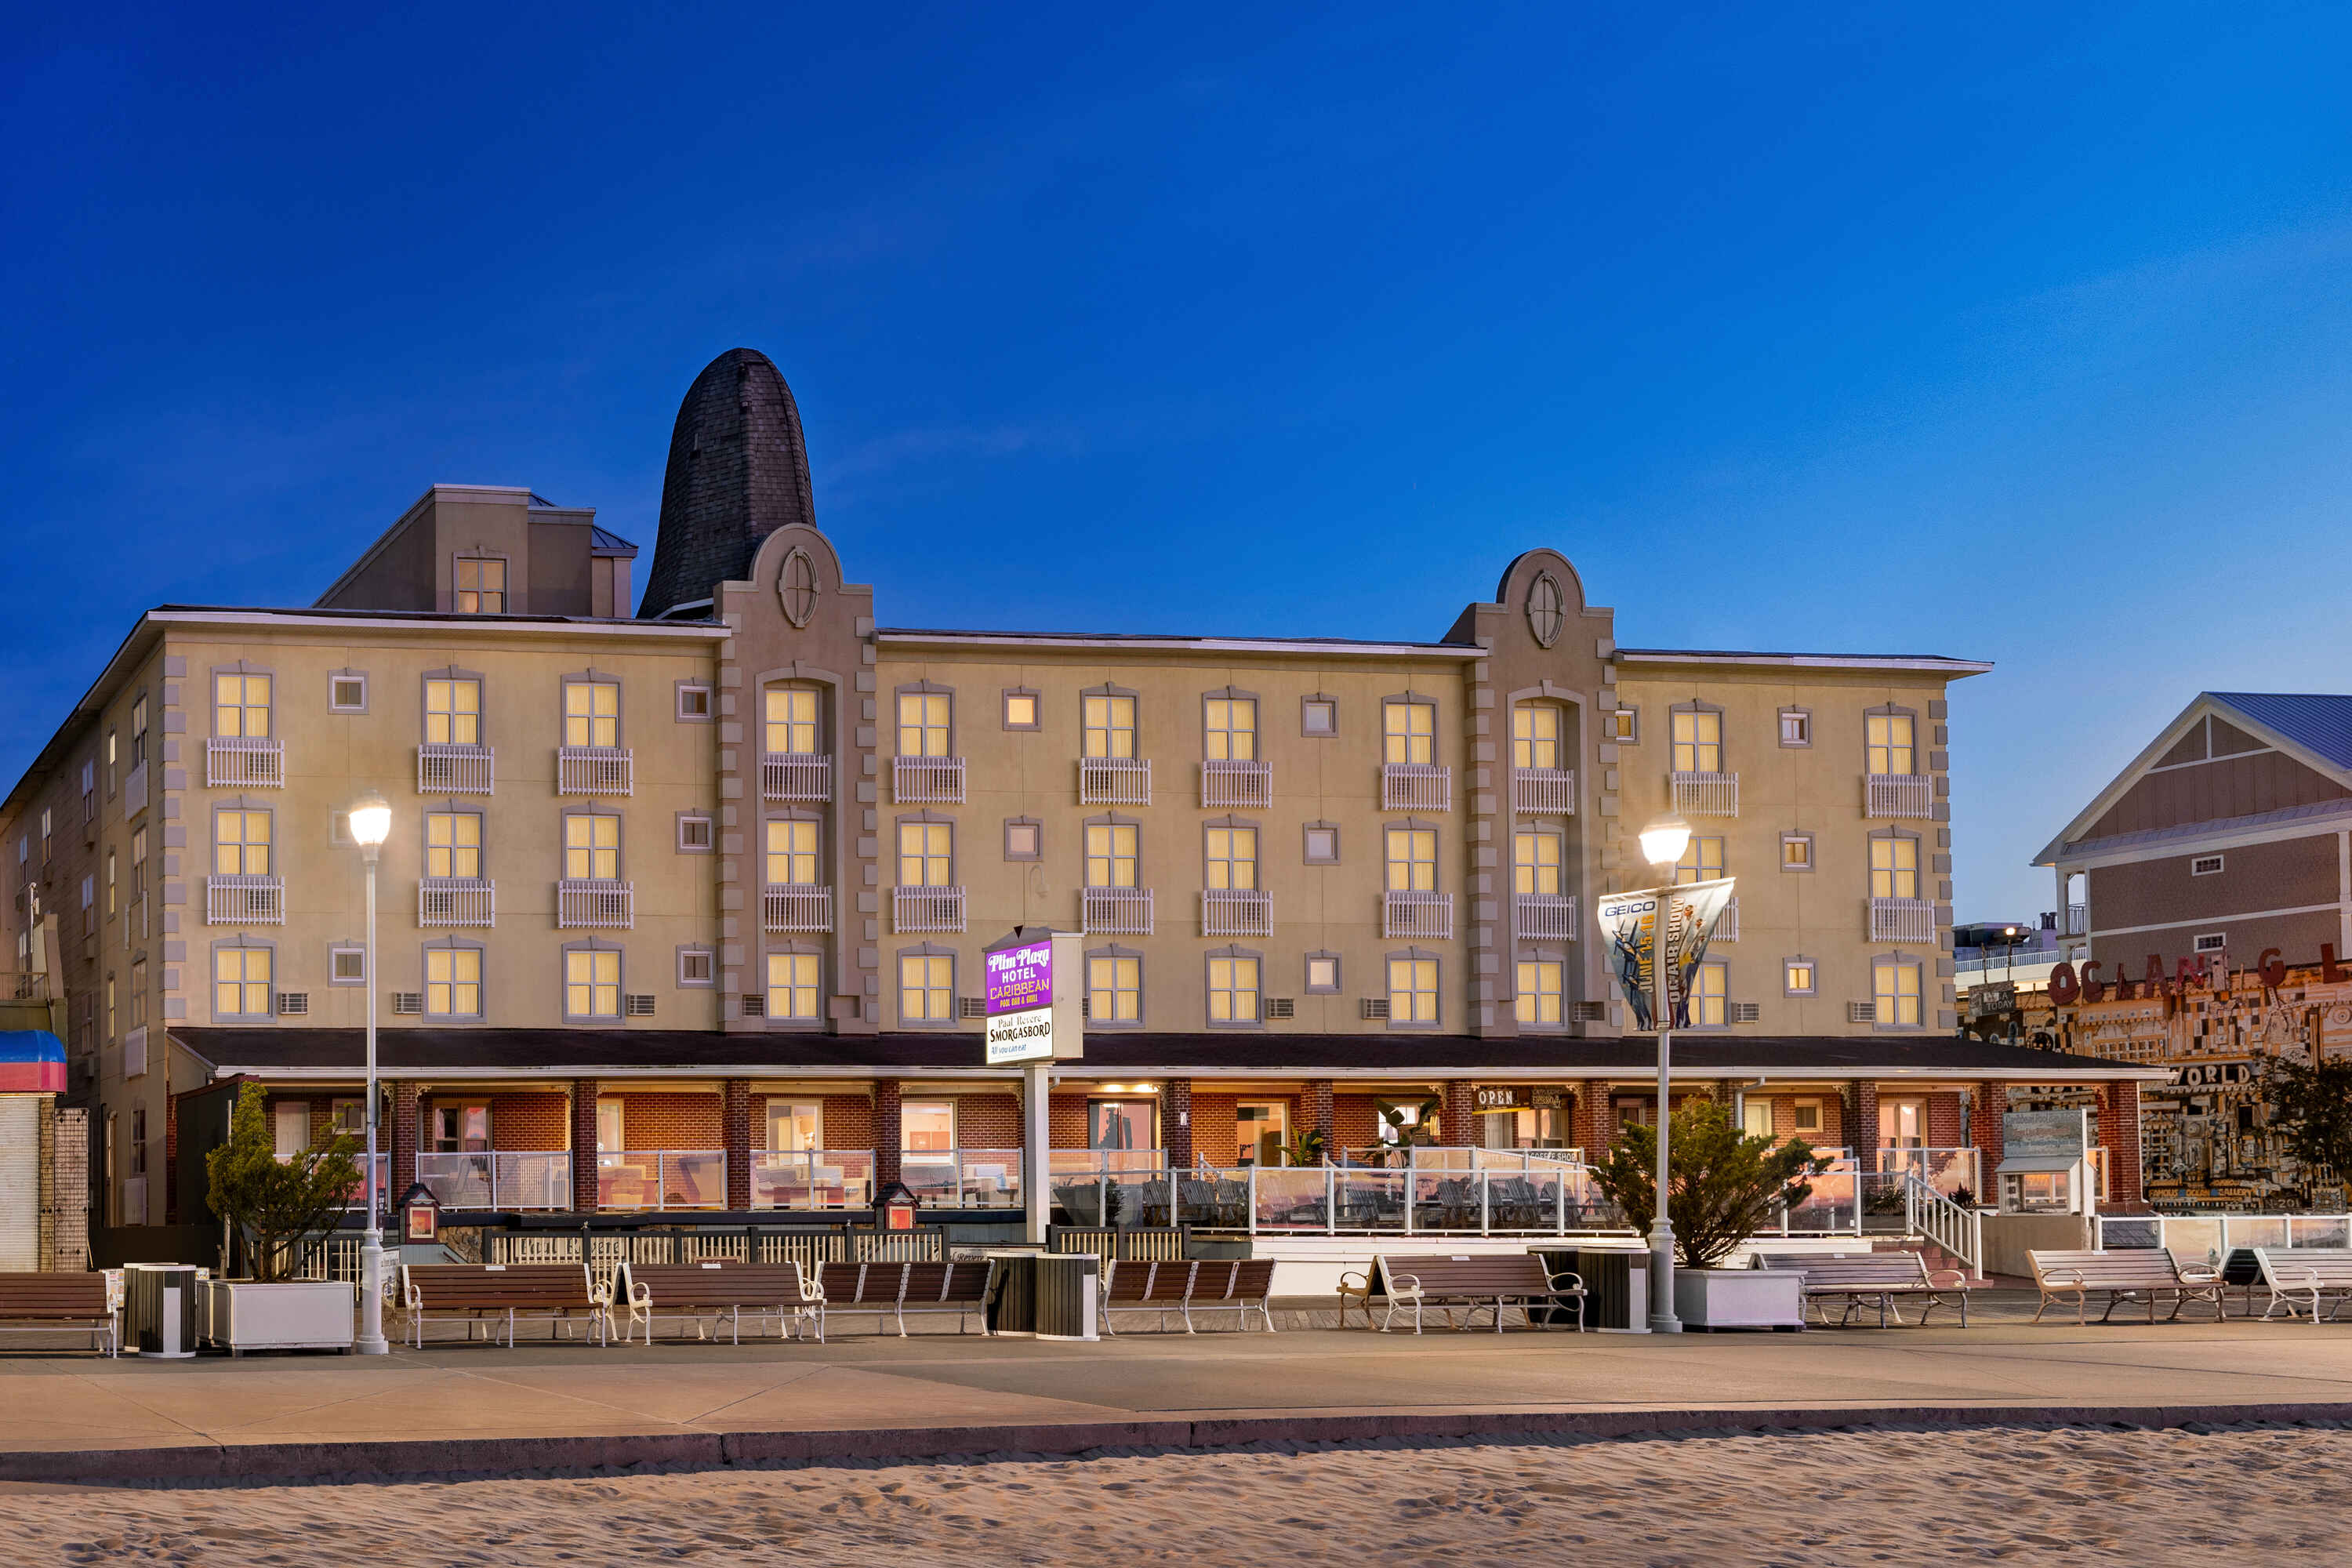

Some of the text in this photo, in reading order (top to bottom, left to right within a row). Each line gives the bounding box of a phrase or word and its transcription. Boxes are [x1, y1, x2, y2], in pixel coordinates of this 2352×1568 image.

[1605, 901, 1656, 916] GEICO
[1668, 896, 1685, 944] SHOW
[988, 948, 1050, 973] Plim Plaza
[1666, 945, 1680, 976] AIR
[1002, 966, 1036, 983] HOTEL
[1638, 956, 1654, 993] JUNE
[990, 978, 1050, 1000] CARIBBEAN
[998, 1014, 1042, 1029] Paul Revere
[990, 1022, 1051, 1043] SMORGASBORD
[1479, 1091, 1513, 1105] OPEN
